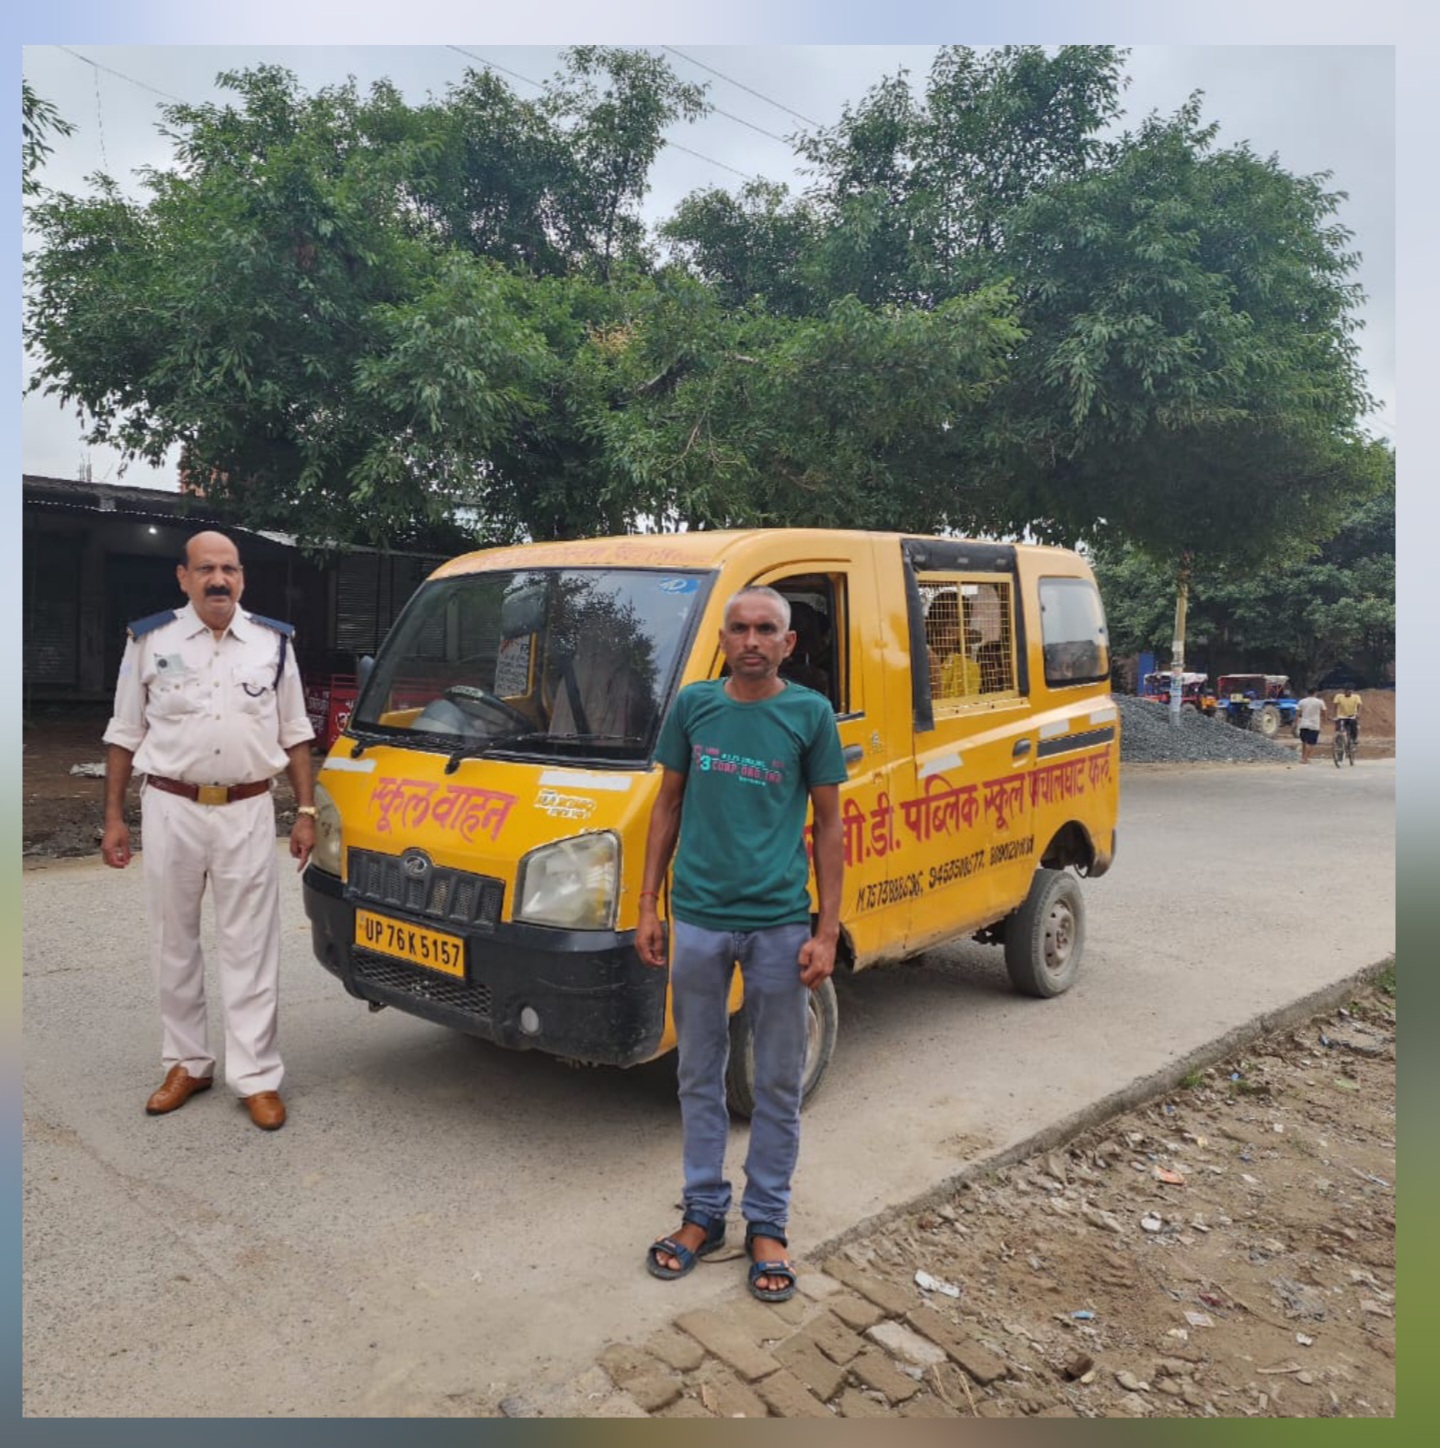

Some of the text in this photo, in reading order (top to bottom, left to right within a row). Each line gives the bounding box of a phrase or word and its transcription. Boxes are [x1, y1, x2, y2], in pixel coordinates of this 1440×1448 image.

[368, 776, 440, 836] स्कूल
[433, 784, 518, 845] वाहन
[900, 773, 979, 842] पब्लिक
[982, 772, 1026, 830] स्कूल
